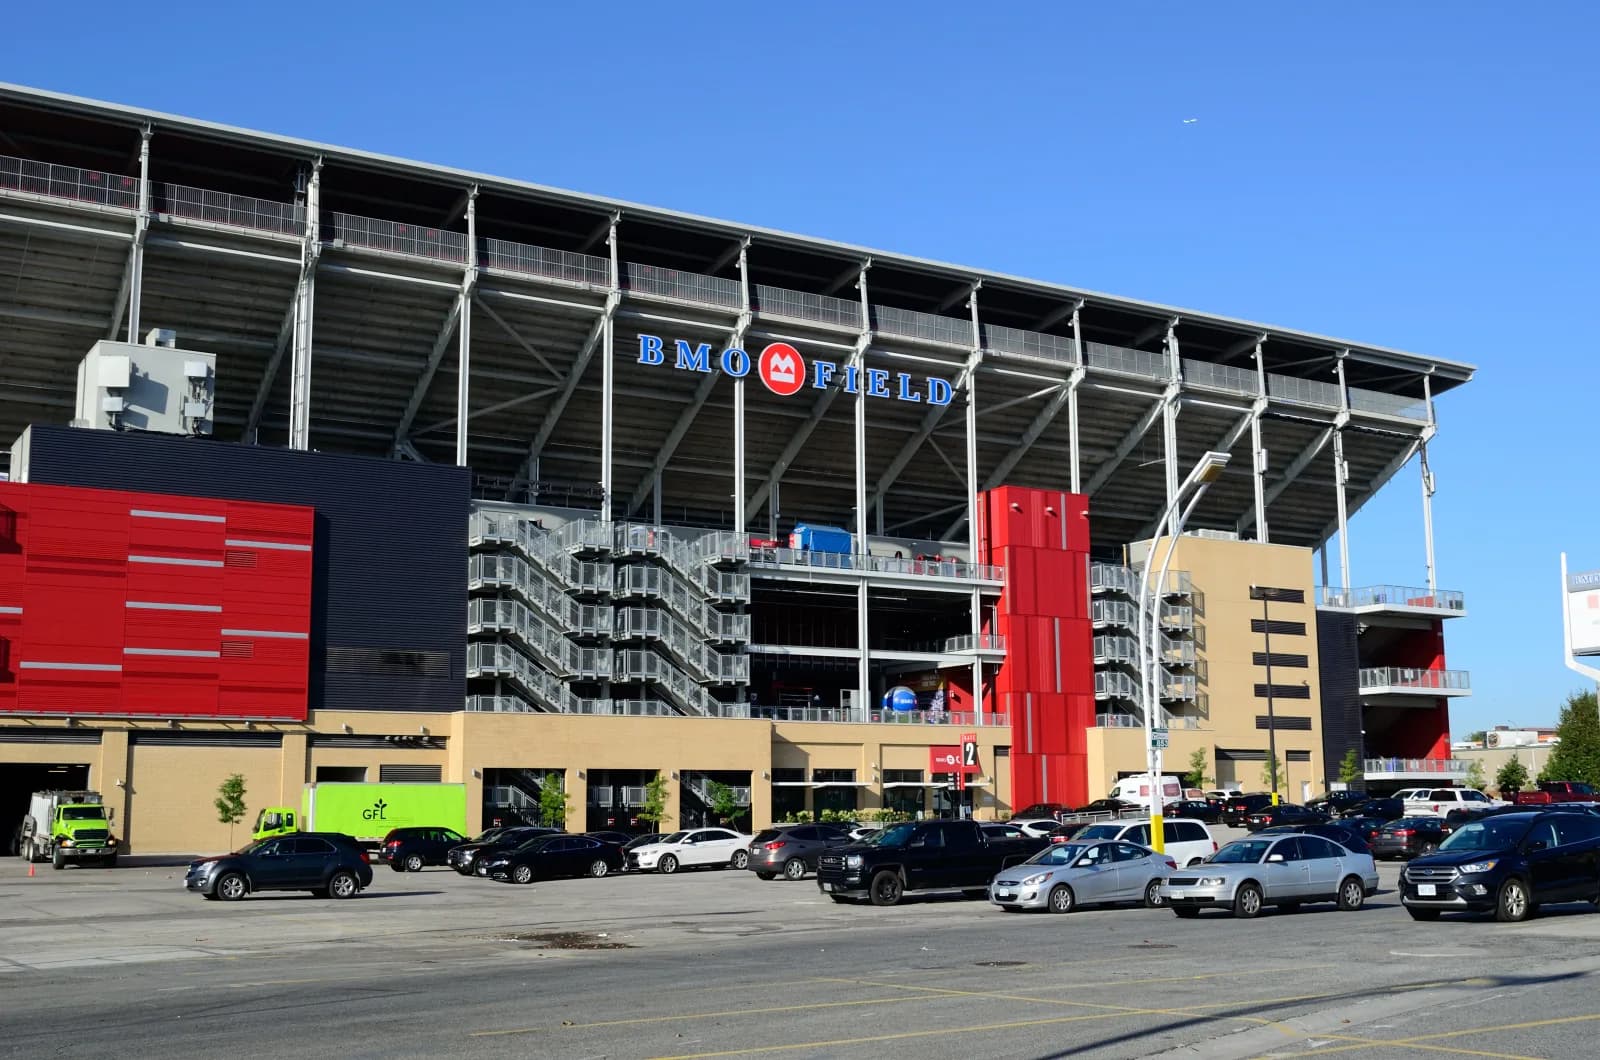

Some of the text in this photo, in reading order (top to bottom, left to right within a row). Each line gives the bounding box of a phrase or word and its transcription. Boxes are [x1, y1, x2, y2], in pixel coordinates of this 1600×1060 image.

[637, 334, 953, 406] BMO FIELD
[966, 743, 974, 765] 2
[363, 804, 387, 820] GFL
